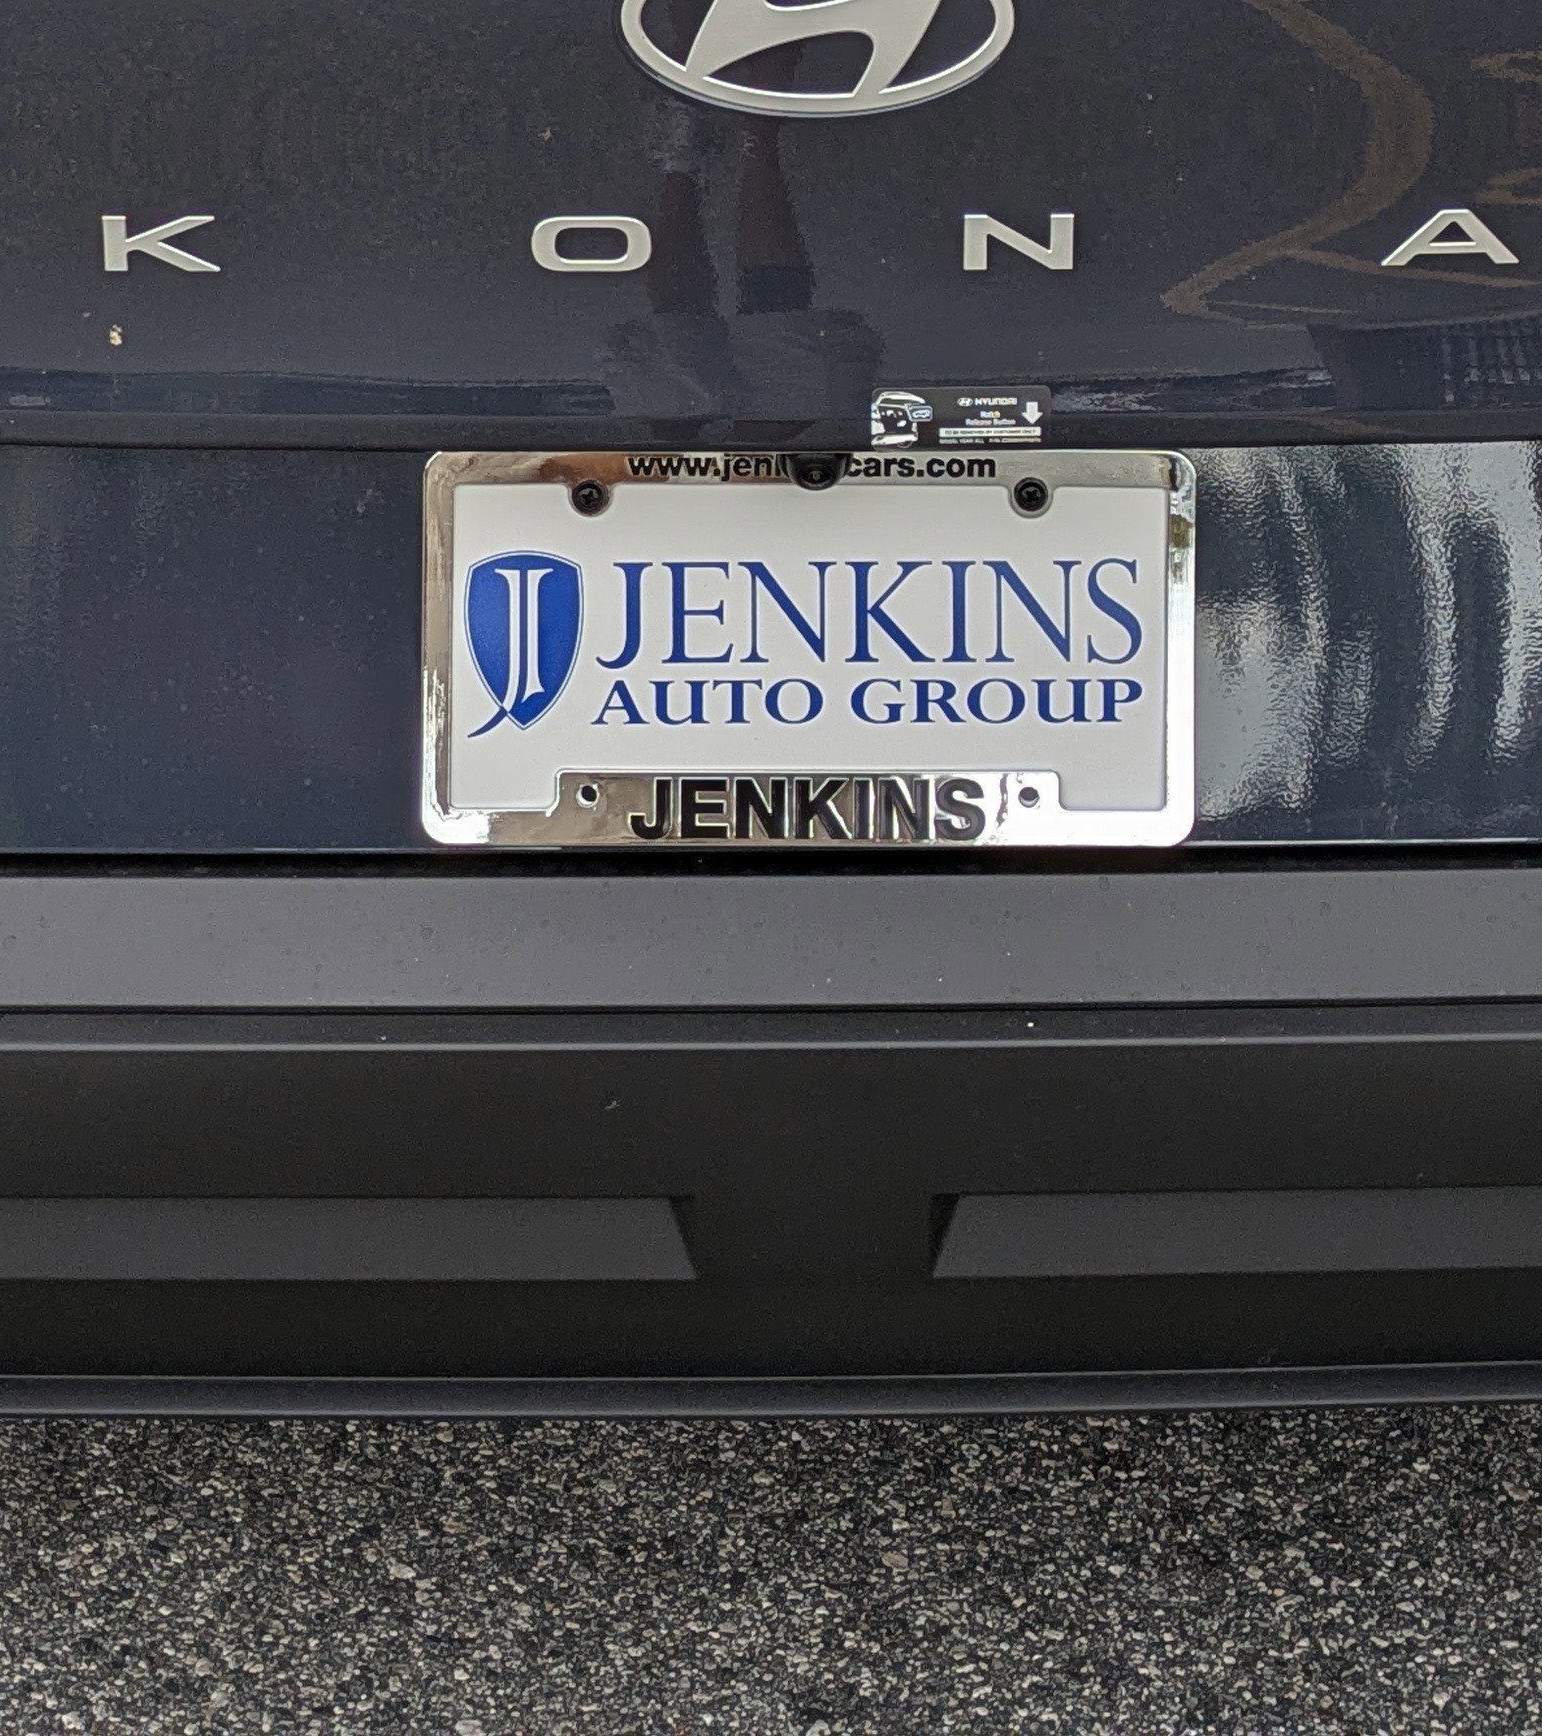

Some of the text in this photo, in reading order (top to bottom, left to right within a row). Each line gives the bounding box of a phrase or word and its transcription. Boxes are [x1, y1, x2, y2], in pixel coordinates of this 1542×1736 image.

[101, 207, 1521, 273] KONA
[974, 397, 1018, 406] HYUNDAI
[628, 455, 996, 481] www.jencars.com
[594, 557, 1144, 669] JENKINS
[590, 677, 1143, 725] AUTO GROUP
[628, 779, 986, 841] JENKINS
